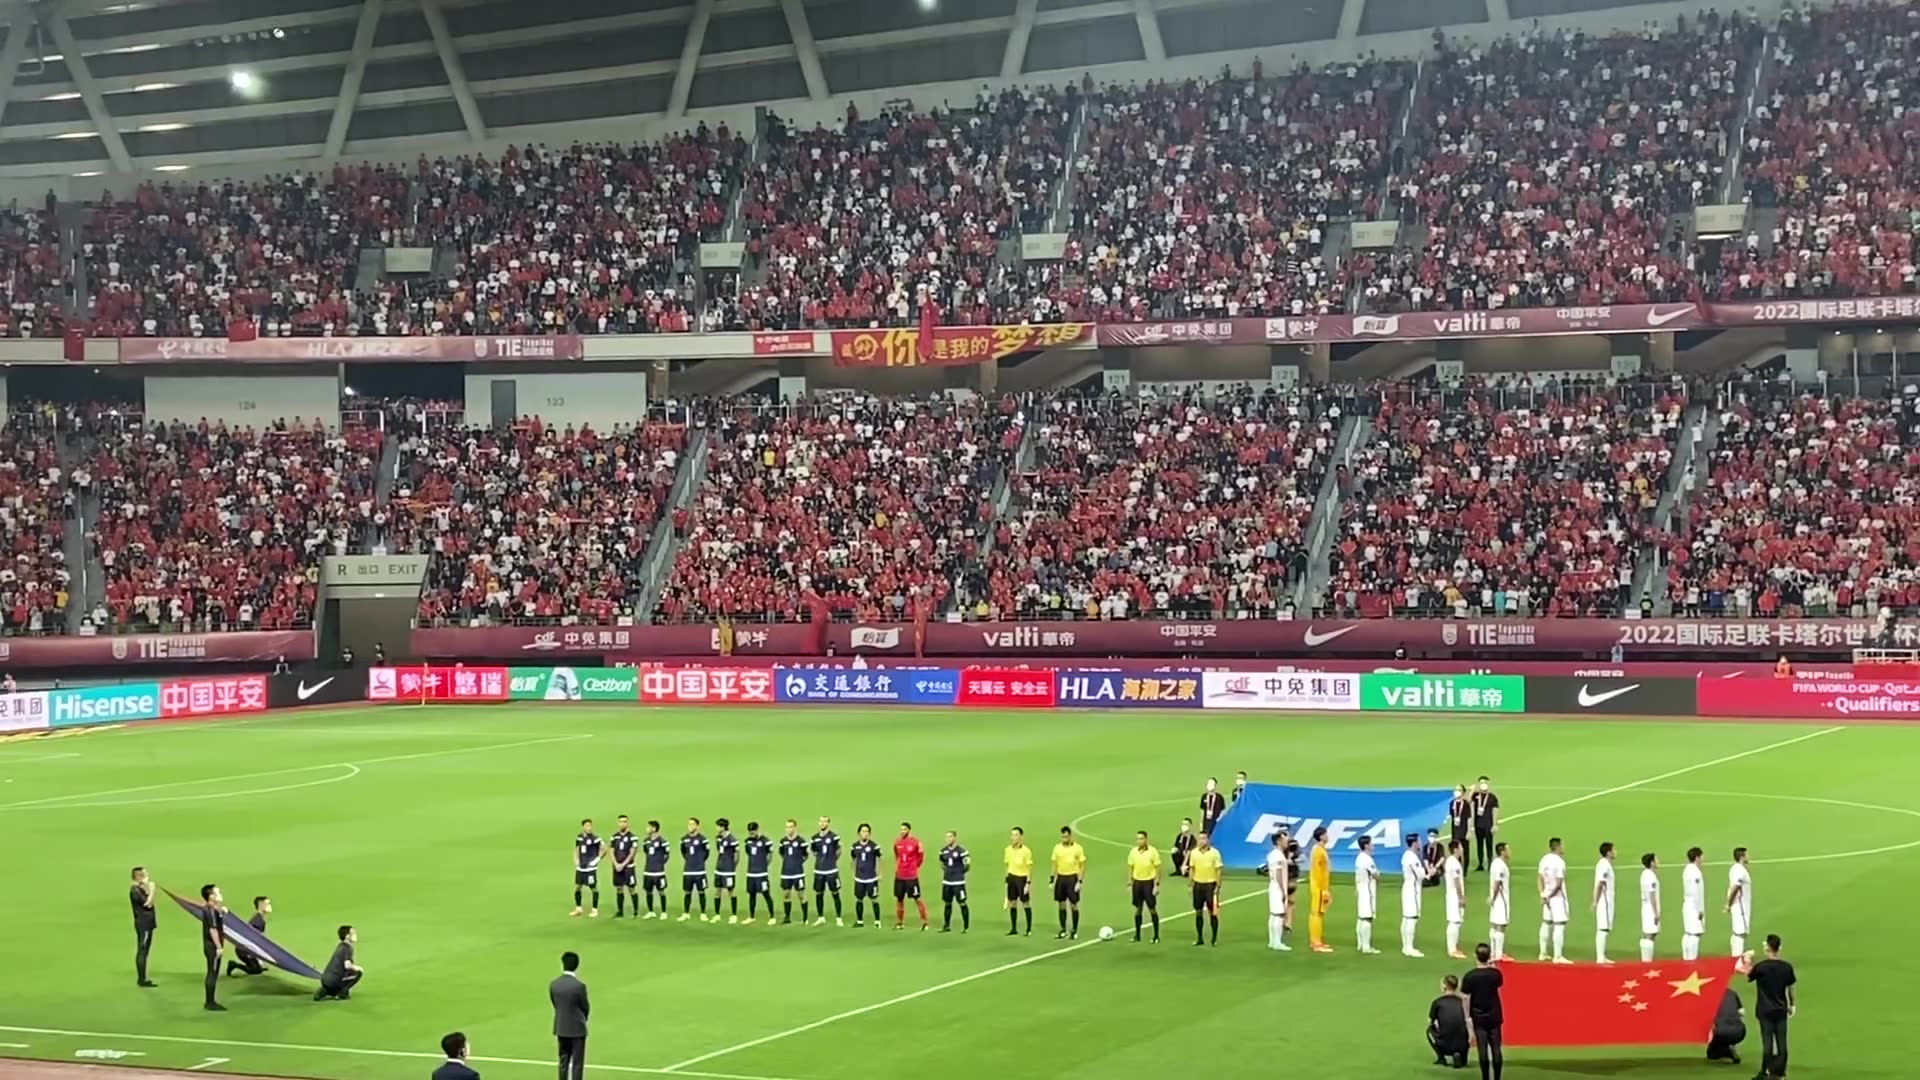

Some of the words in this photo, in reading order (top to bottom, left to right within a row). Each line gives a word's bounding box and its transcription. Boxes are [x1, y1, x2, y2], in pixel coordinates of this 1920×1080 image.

[1433, 313, 1486, 333] vatti
[1556, 306, 1611, 320] 中国平安
[495, 338, 522, 357] TIE
[1108, 374, 1126, 384] 121
[338, 564, 347, 576] R
[388, 564, 418, 575] EXIT
[565, 631, 630, 645] 中免集团
[982, 626, 1039, 647] vatti
[1160, 624, 1217, 637] 中国平安
[1467, 624, 1497, 645] TIE
[137, 638, 168, 658] TIE
[401, 673, 442, 695] 蒙牛
[644, 670, 770, 700] 中国平安
[814, 673, 893, 692] 交通銀行
[968, 680, 1006, 695] 天翼云
[1010, 681, 1049, 696] 安全云
[1060, 677, 1116, 700] HLA
[1225, 676, 1251, 691] cdf
[1264, 677, 1351, 696] 中免集团
[1792, 683, 1816, 693] FIFA
[1816, 683, 1857, 694] WORLD
[1858, 683, 1881, 694] CUP
[162, 679, 265, 713] 中国平安
[1381, 680, 1454, 707] vatti
[1459, 688, 1503, 707] 華帝
[55, 694, 153, 720] Hisense
[1834, 696, 1920, 714] Qualifiers
[1244, 813, 1402, 849] FIFA
